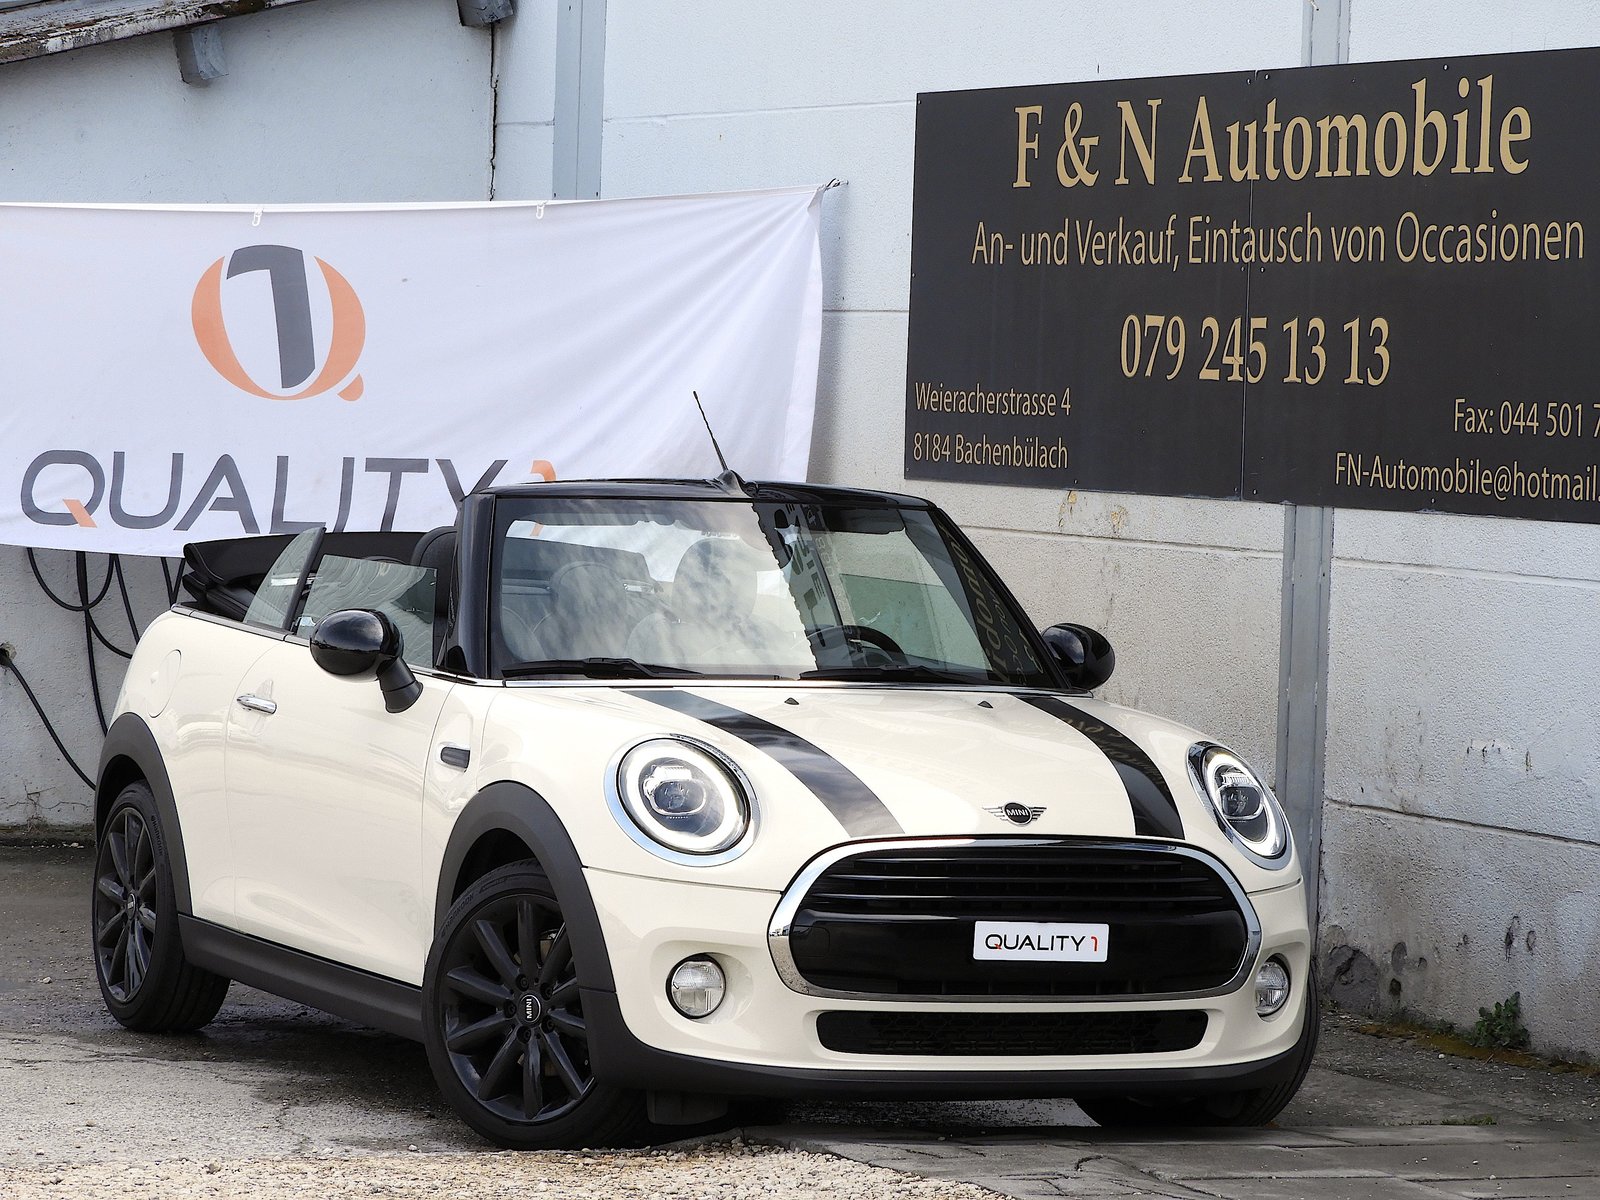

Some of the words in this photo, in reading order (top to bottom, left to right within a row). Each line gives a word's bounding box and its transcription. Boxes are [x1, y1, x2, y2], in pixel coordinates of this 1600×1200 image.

[1013, 106, 1043, 188] F
[1056, 102, 1100, 188] &
[1115, 98, 1162, 185] N
[1179, 75, 1531, 183] Automobile
[972, 221, 1014, 264] An-
[1022, 218, 1069, 266] und
[1076, 214, 1179, 272] Verkauf,
[1189, 211, 1322, 264] Eintausch
[1331, 226, 1385, 263] von
[1397, 210, 1584, 263] Occasionen
[1122, 315, 1186, 380] 079
[1200, 316, 1268, 384] 245
[1284, 317, 1327, 385] 13
[1344, 317, 1390, 386] 13
[915, 382, 1057, 416] Weieracherstrasse
[1060, 387, 1071, 416] 4
[1454, 398, 1494, 434] Fax:
[1500, 401, 1539, 435] 044
[1546, 402, 1582, 437] 501
[913, 432, 951, 462] 8184
[955, 434, 1068, 469] Bachenbülach
[1006, 807, 1029, 817] MINI
[985, 933, 1086, 952] QUALITY
